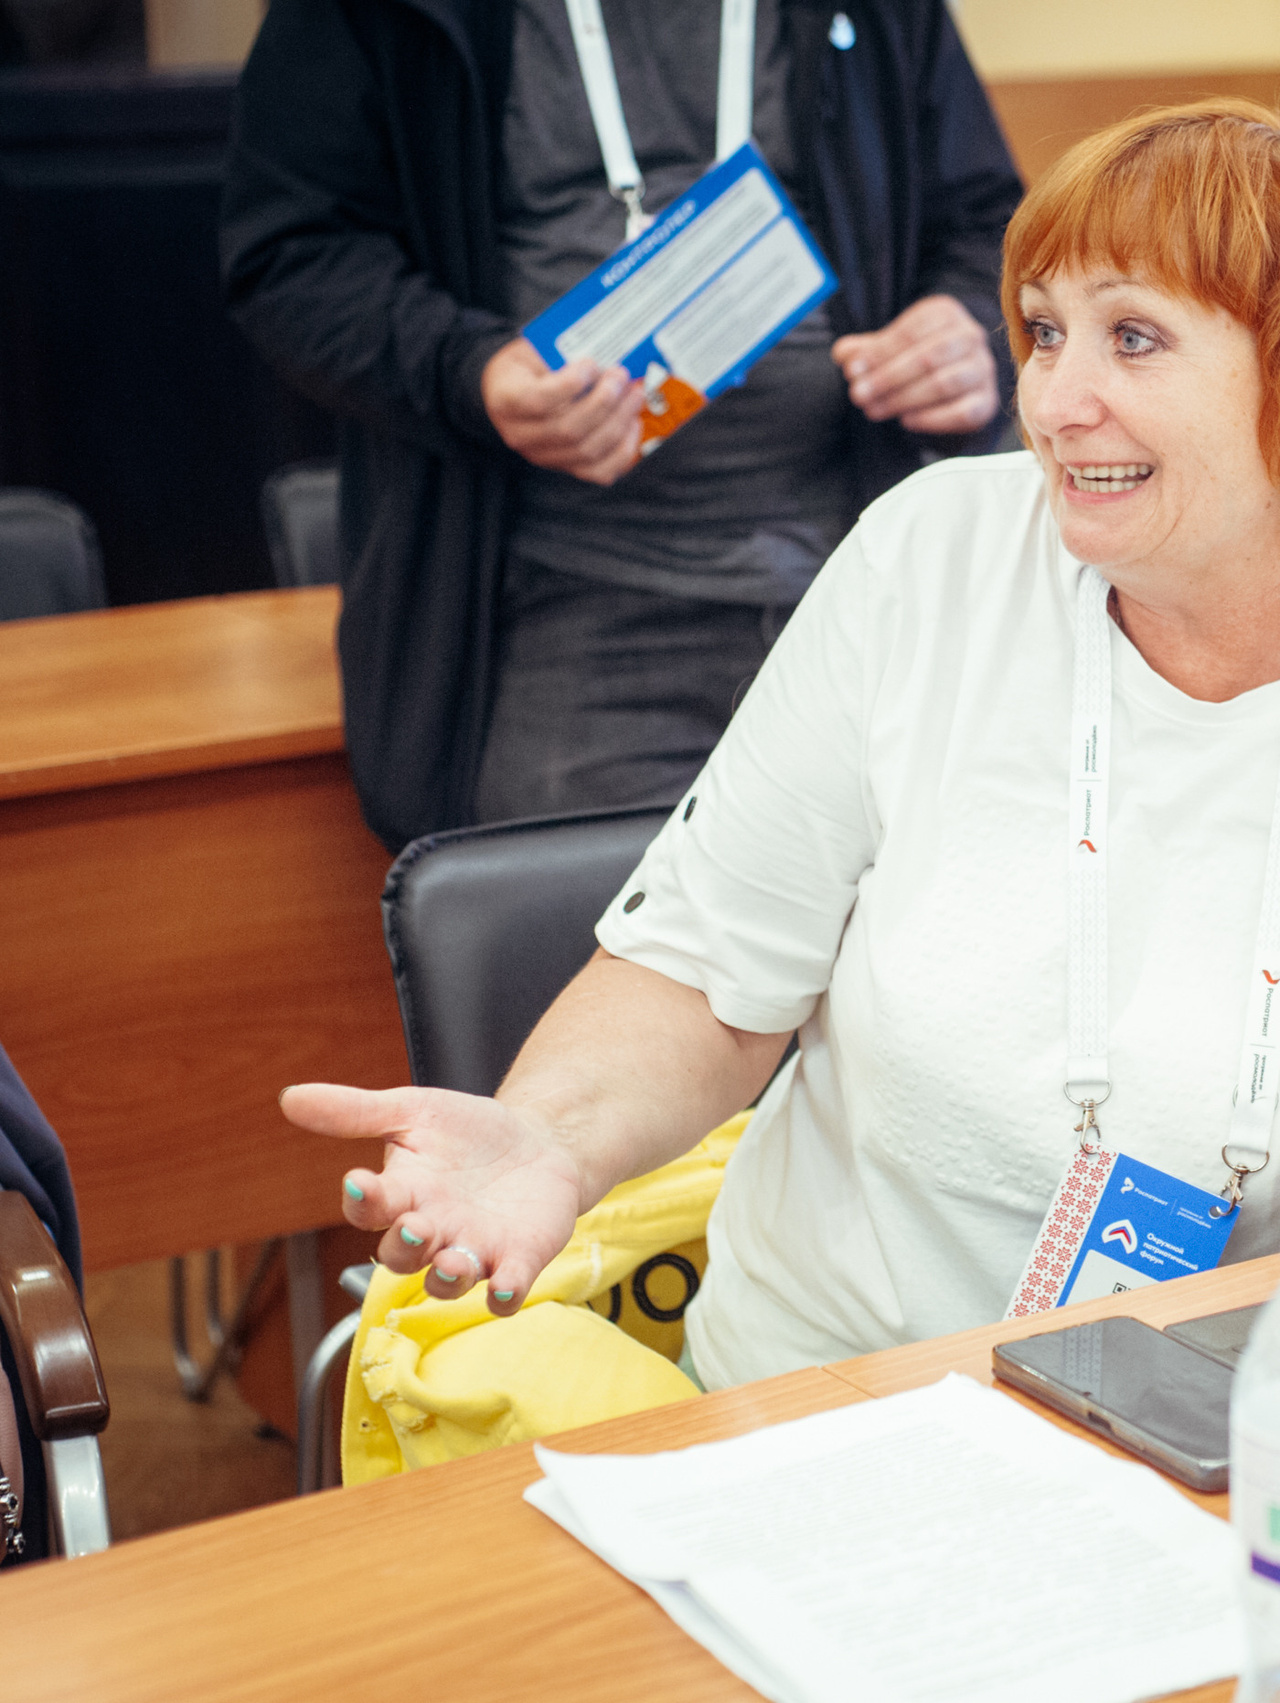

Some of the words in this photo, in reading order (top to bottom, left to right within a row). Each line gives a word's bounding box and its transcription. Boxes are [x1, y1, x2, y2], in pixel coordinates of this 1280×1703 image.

[1262, 987, 1274, 1037] Роспатриот
[1147, 1233, 1184, 1254] Окружной
[1140, 1250, 1164, 1265] форум
[1143, 1242, 1198, 1271] патриотический
